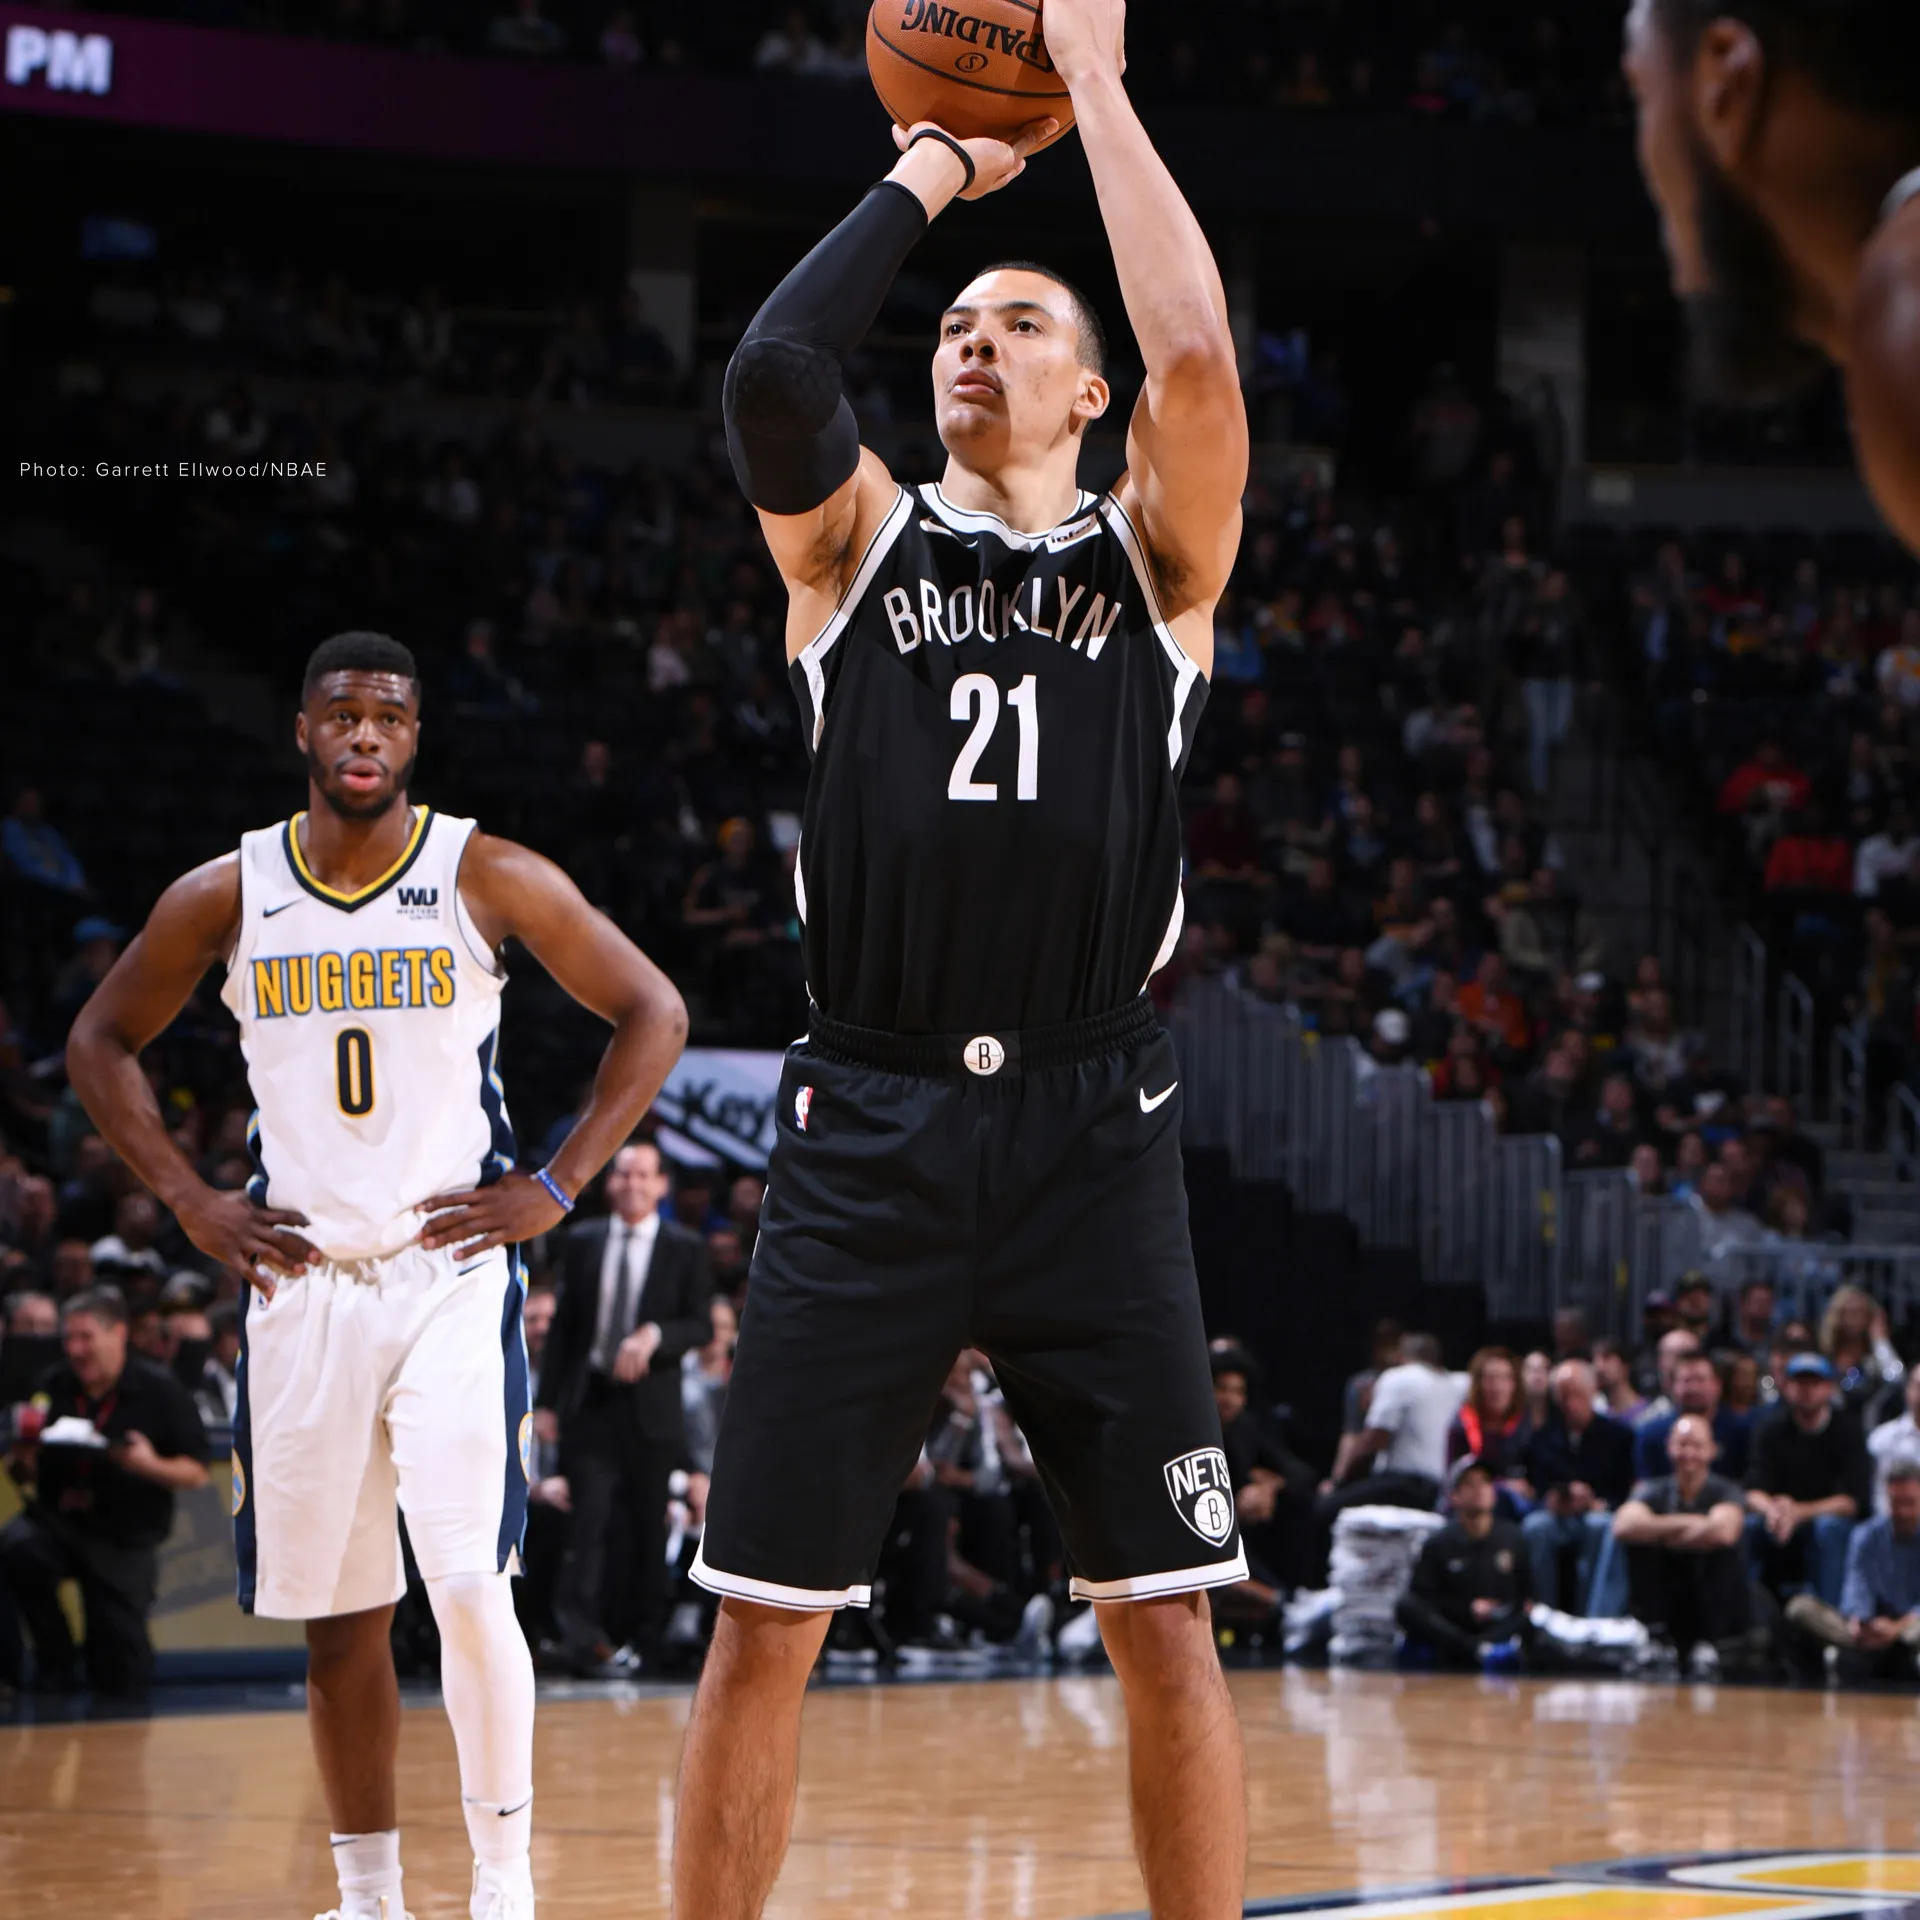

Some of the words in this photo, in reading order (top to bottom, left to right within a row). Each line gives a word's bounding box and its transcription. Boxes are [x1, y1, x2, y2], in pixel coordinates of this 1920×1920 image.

[6, 25, 113, 96] PM
[901, 0, 1055, 73] PALDING
[883, 576, 1122, 661] BROOKLYN
[947, 673, 1039, 800] 21
[397, 887, 438, 906] WU
[251, 946, 456, 1018] NUGGETS
[335, 1027, 375, 1117] 0
[979, 1043, 991, 1069] B
[1172, 1452, 1230, 1501] NETS
[1208, 1498, 1222, 1530] B
